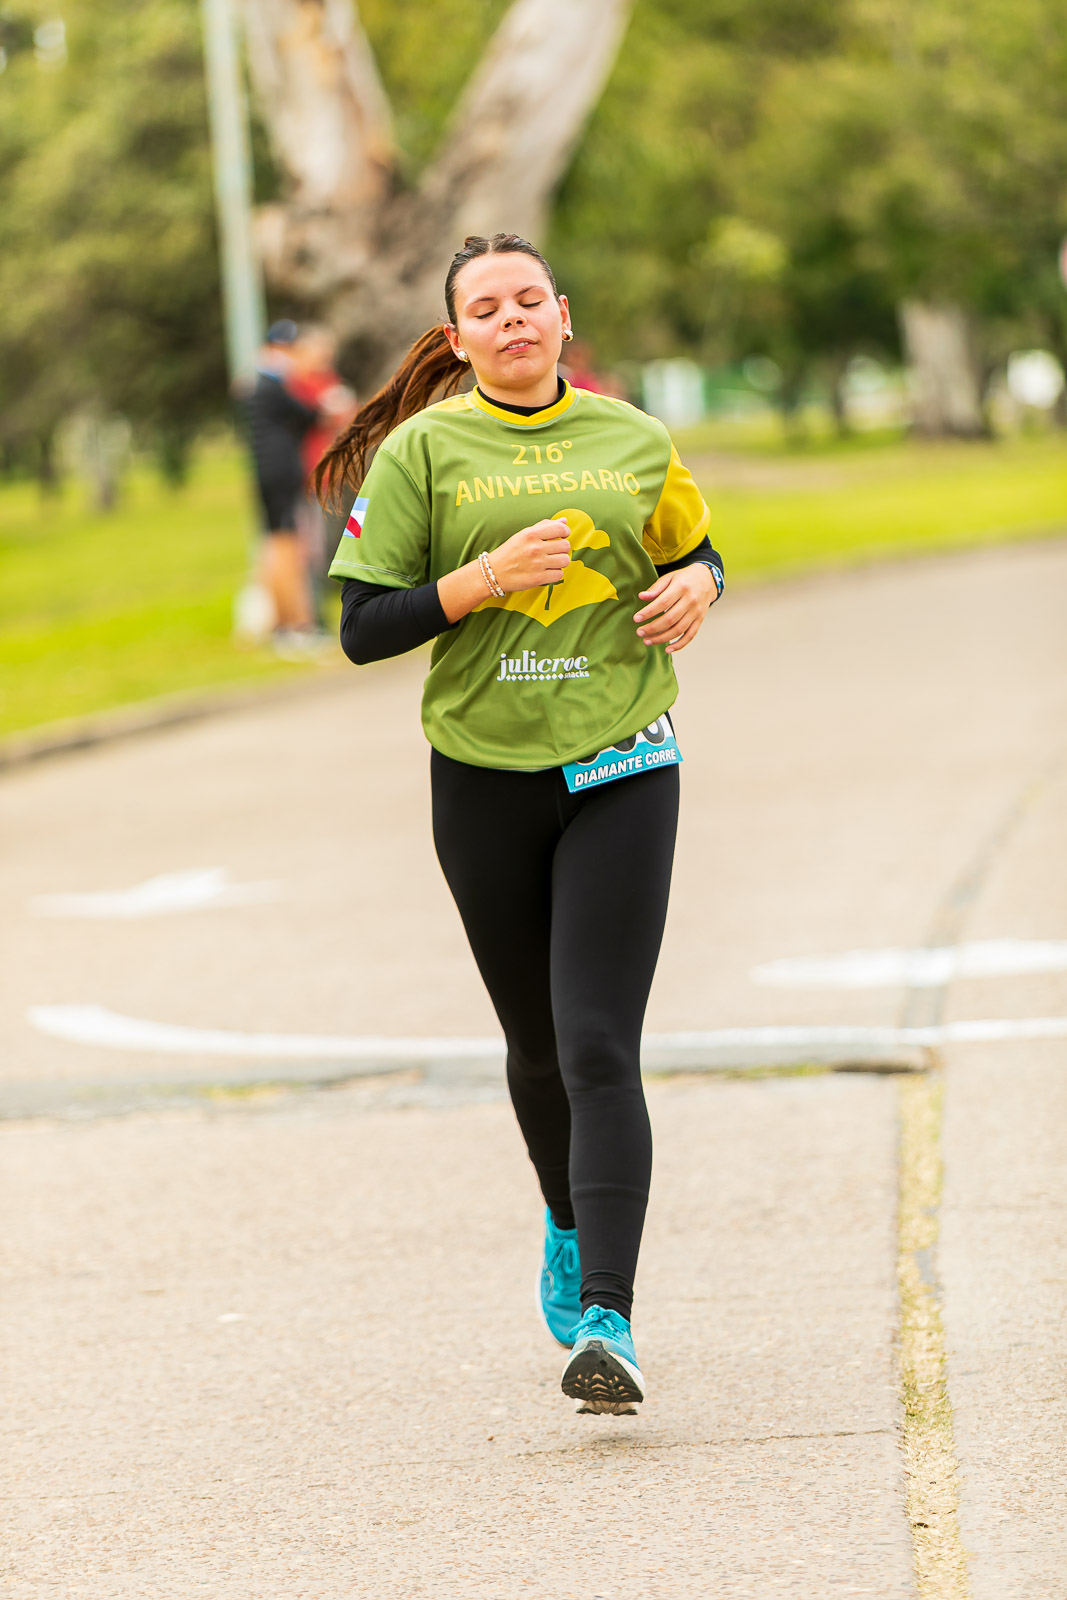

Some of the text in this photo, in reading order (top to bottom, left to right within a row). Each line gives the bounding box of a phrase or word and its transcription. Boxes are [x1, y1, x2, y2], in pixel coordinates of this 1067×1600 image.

[456, 469, 641, 507] ANIVERSARIO
[496, 650, 589, 682] julicroc
[564, 670, 590, 680] snacks
[574, 748, 677, 788] DIAMANTE CORRE
